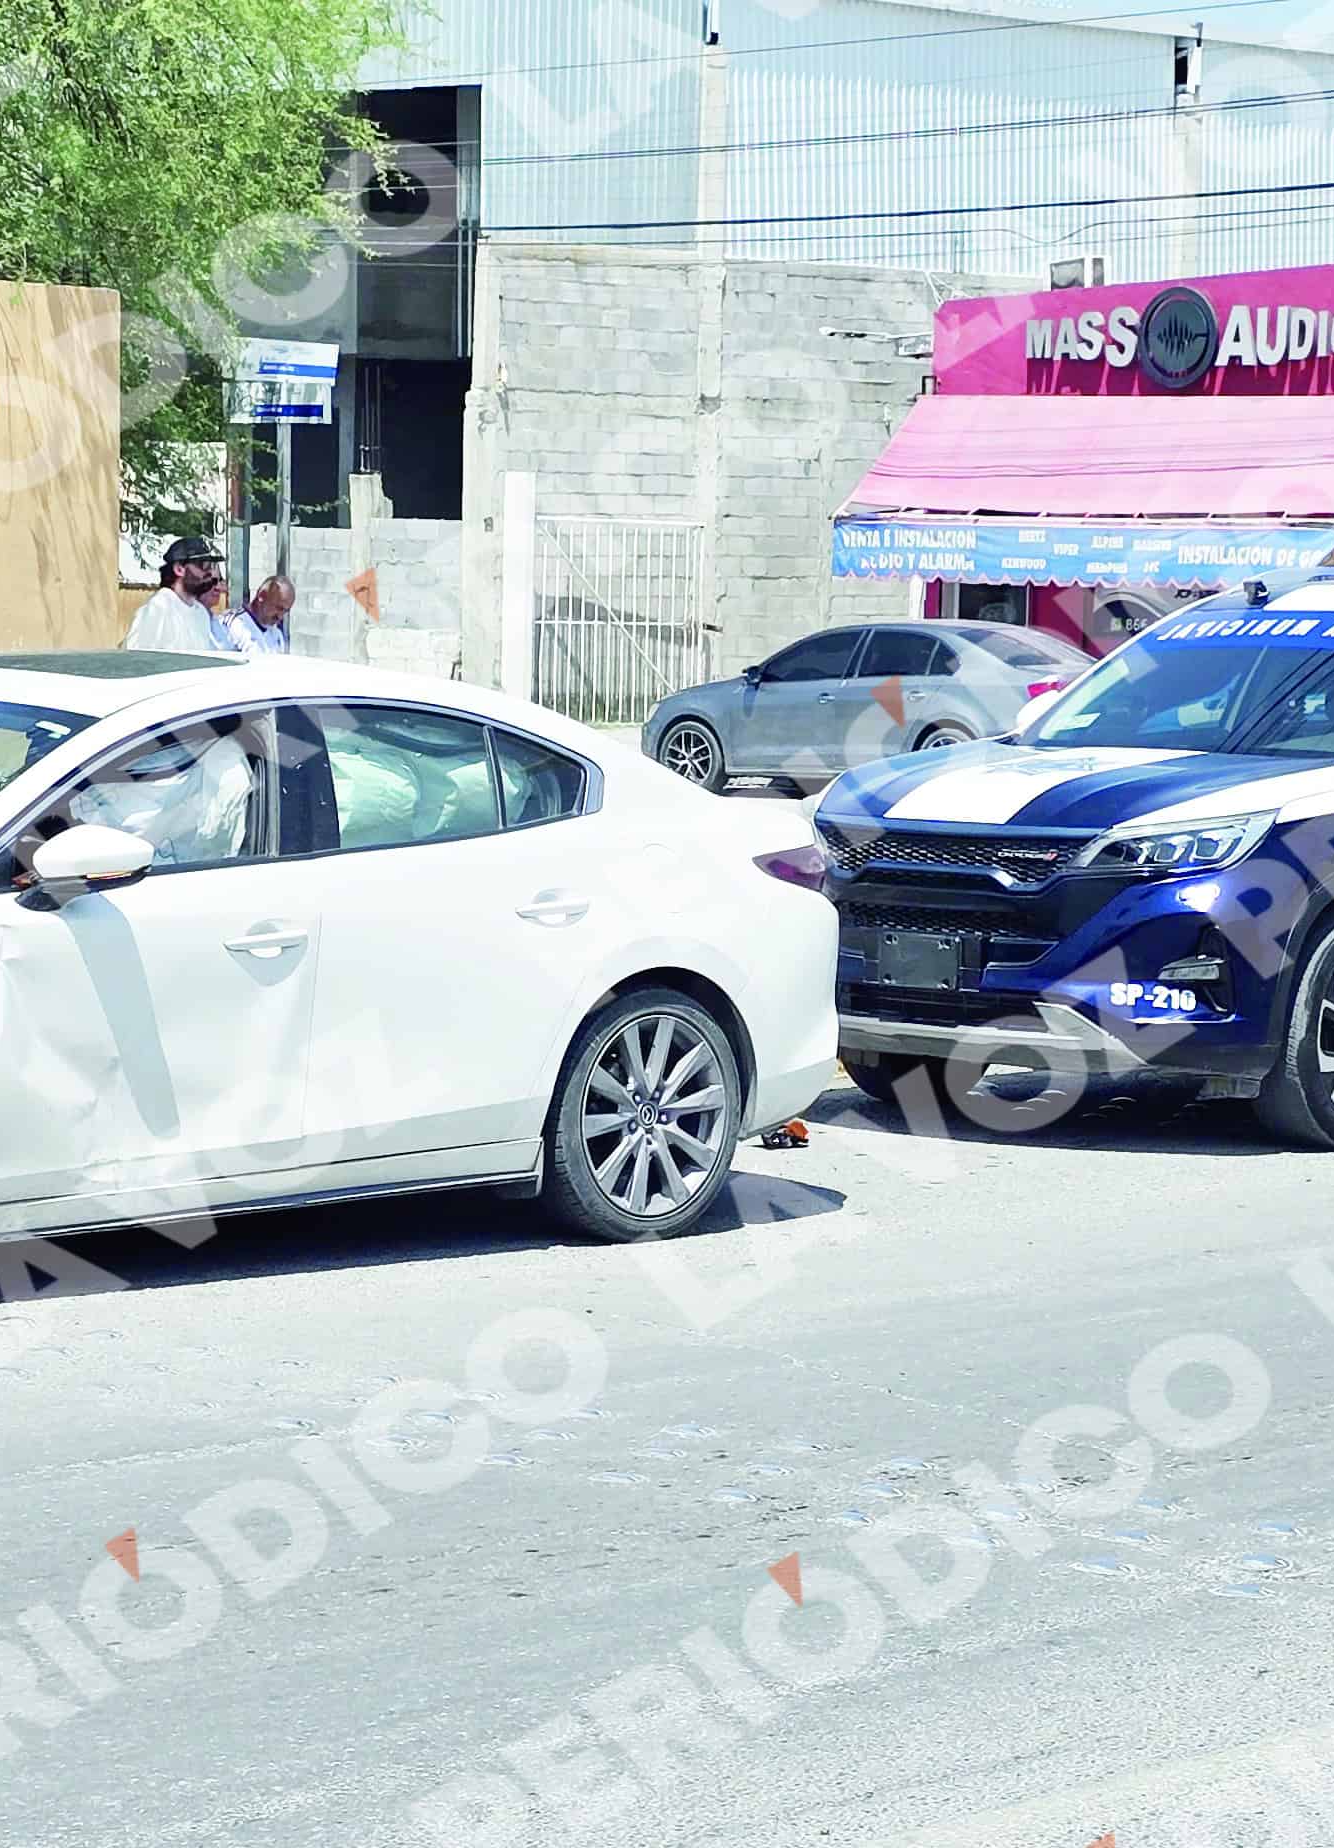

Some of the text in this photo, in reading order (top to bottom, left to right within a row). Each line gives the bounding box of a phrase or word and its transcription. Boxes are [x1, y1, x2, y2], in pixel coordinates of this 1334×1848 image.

[1026, 306, 1143, 368] MASS
[842, 528, 880, 548] VENTA
[894, 528, 977, 549] INSTALACION
[1177, 543, 1272, 566] INSTALACION
